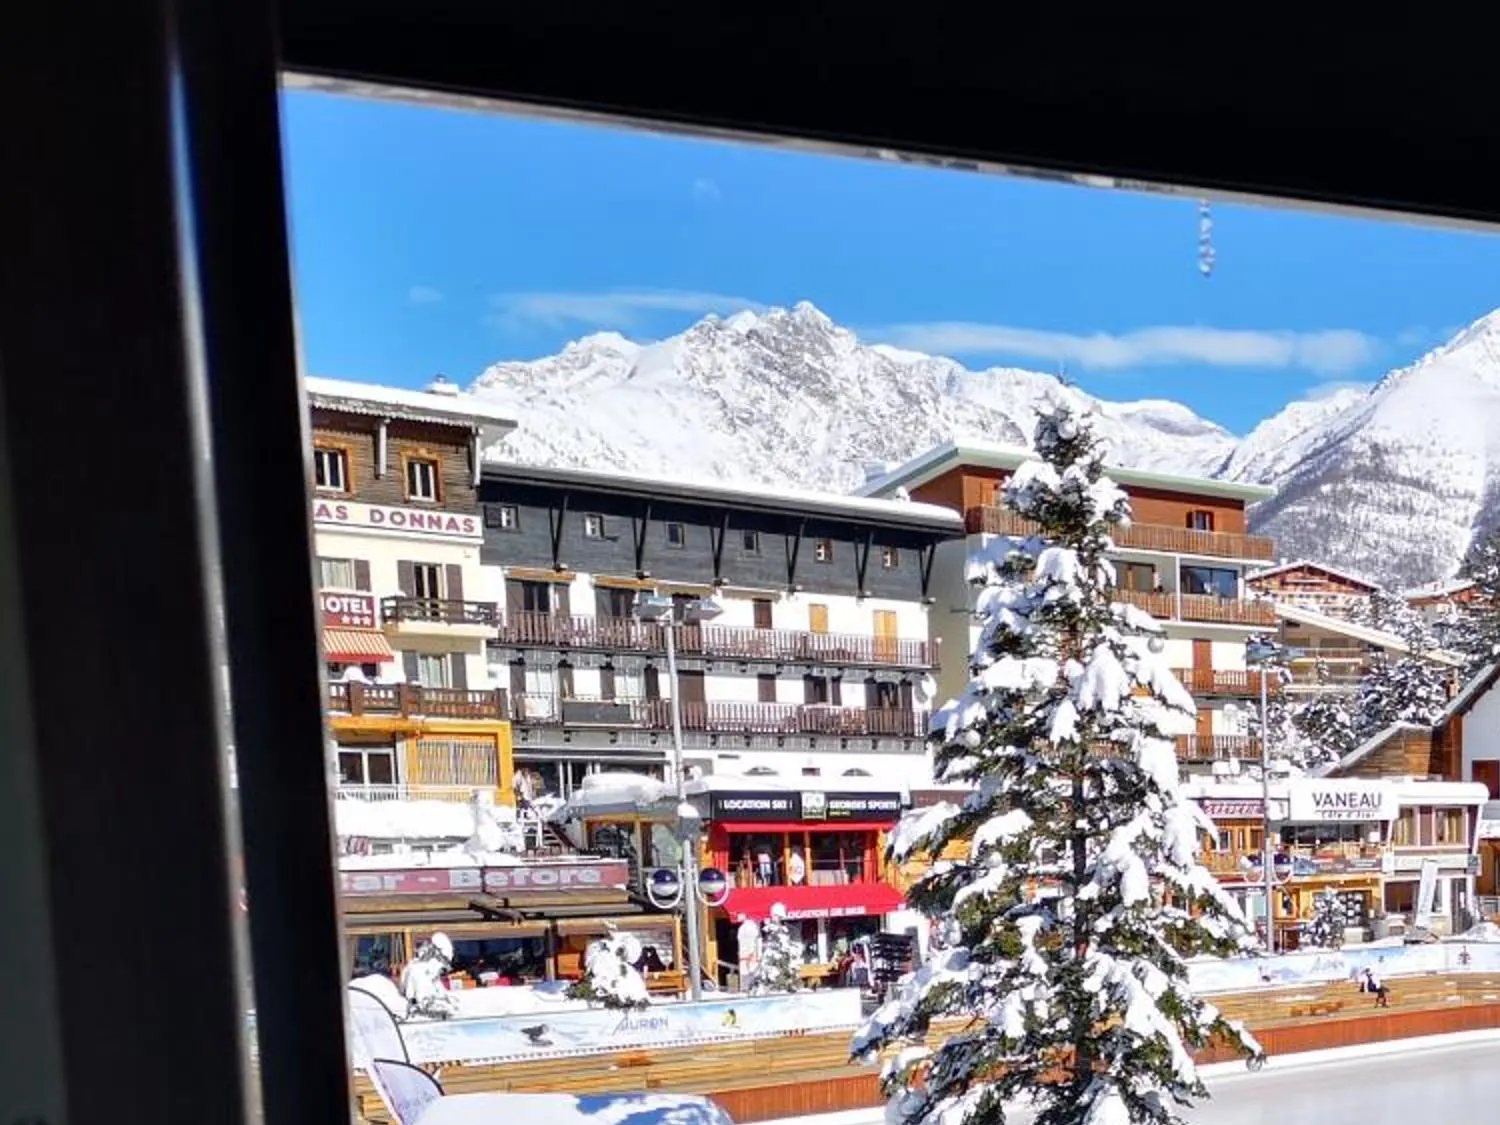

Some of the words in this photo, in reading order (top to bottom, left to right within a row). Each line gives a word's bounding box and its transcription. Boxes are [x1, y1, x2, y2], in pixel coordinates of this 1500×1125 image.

[369, 508, 475, 533] DONNAS
[723, 799, 770, 809] LOCATION
[1312, 792, 1382, 808] VANEAU
[342, 871, 404, 892] ar
[449, 867, 600, 888] Before
